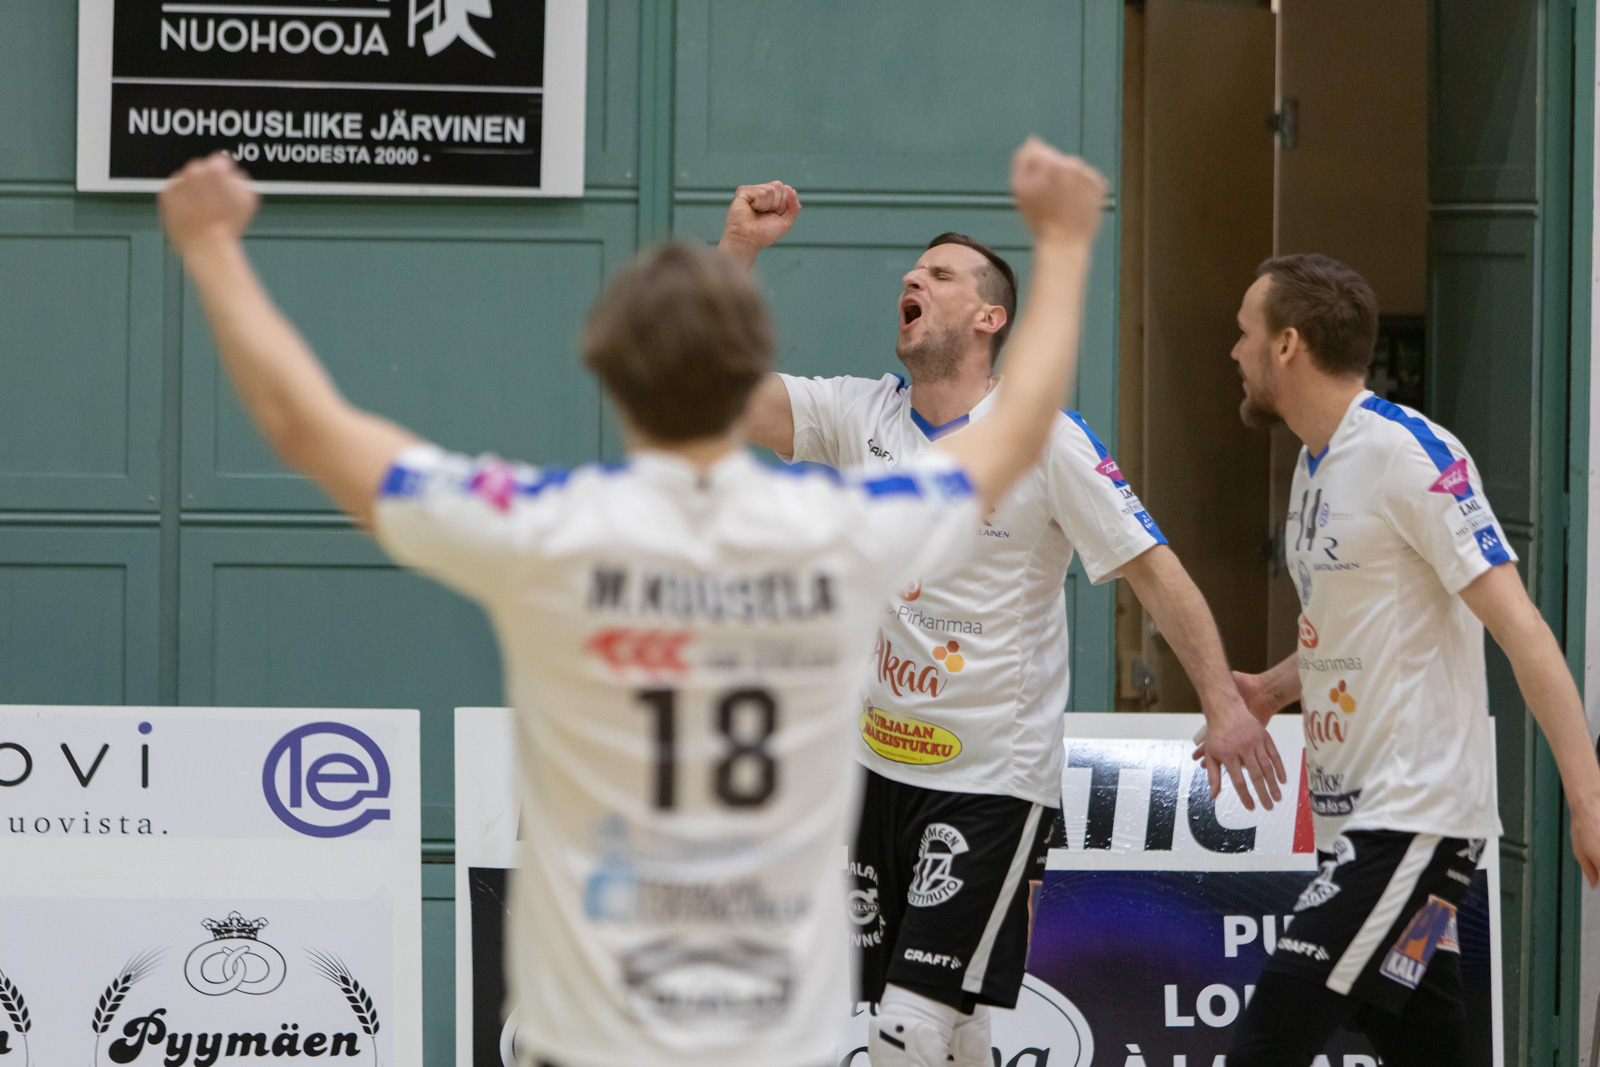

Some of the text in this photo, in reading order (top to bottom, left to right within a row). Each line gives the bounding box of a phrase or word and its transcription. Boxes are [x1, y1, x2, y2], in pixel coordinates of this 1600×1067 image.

[160, 17, 389, 56] NUOHOOJA
[128, 107, 526, 144] NUOHOUSLIIKE JÄRVINEN
[232, 142, 260, 162] JO
[263, 143, 371, 165] VUODESTA
[374, 146, 420, 166] 2000
[977, 528, 1010, 538] LAINEN
[863, 721, 954, 758] MAKEISTUKKU
[874, 713, 935, 740] URJALAN
[635, 687, 778, 811] 18
[8, 811, 168, 835] uovista.
[904, 949, 950, 967] CRAFT
[1164, 983, 1256, 1028] LO
[108, 1008, 361, 1067] Pyymäen
